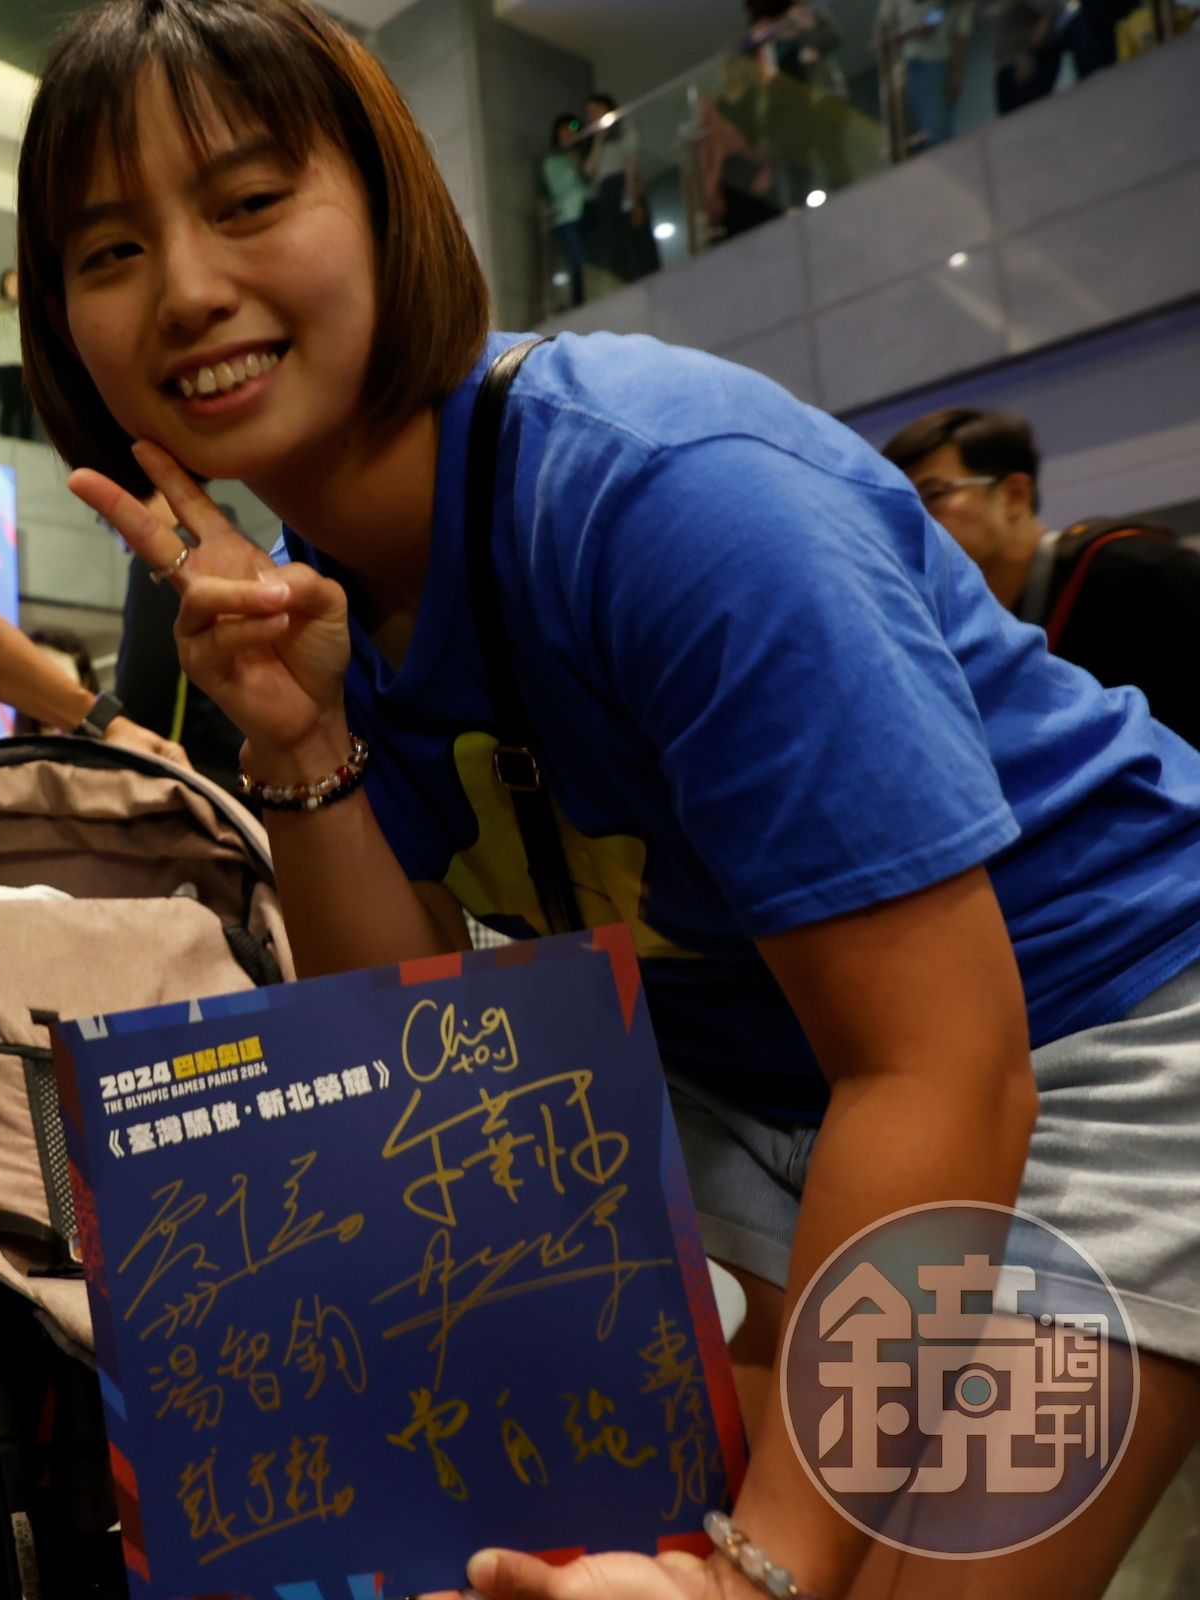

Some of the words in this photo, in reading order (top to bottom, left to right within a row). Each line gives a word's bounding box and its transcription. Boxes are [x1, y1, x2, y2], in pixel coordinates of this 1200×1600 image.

[99, 1060, 172, 1099] 2024
[103, 1099, 124, 1116] THE
[125, 1088, 170, 1111] OLYMPIC
[171, 1079, 206, 1099] GAMES
[207, 1071, 239, 1090] PARIS
[240, 1060, 268, 1081] 2024
